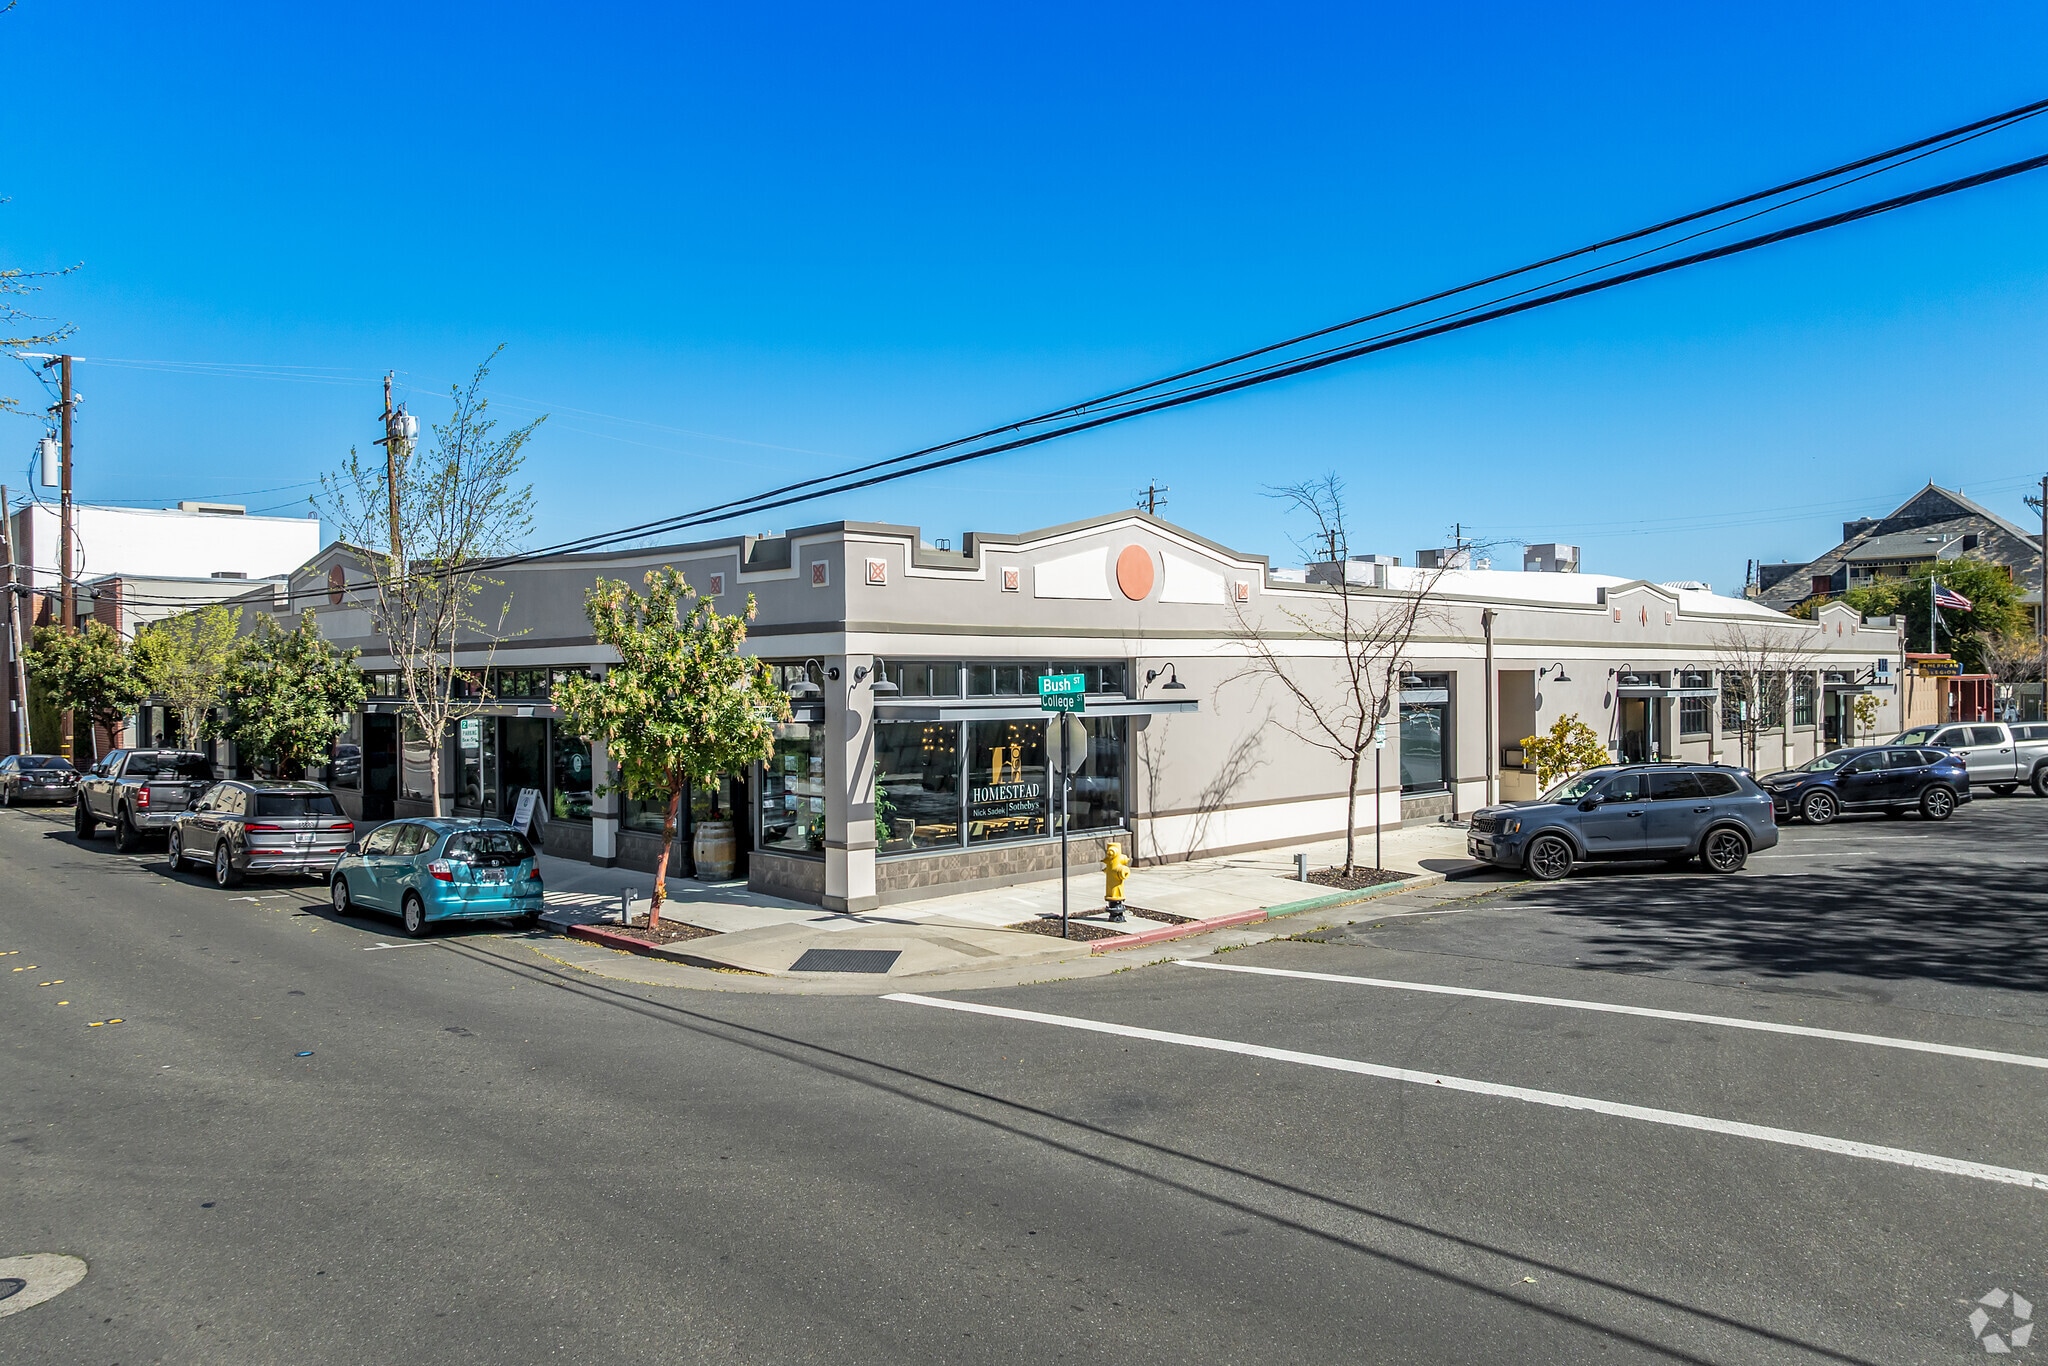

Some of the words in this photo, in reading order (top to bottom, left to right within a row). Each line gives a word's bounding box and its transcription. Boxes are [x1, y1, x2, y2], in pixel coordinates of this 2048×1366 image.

[1043, 678, 1071, 692] Bush
[1073, 676, 1081, 684] ST
[1042, 694, 1074, 711] College
[1077, 694, 1083, 702] ST
[973, 783, 1040, 802] HOMESTEAD
[973, 808, 987, 817] Nick
[987, 806, 1006, 816] Sadek
[1009, 800, 1040, 811] Sotheby's
